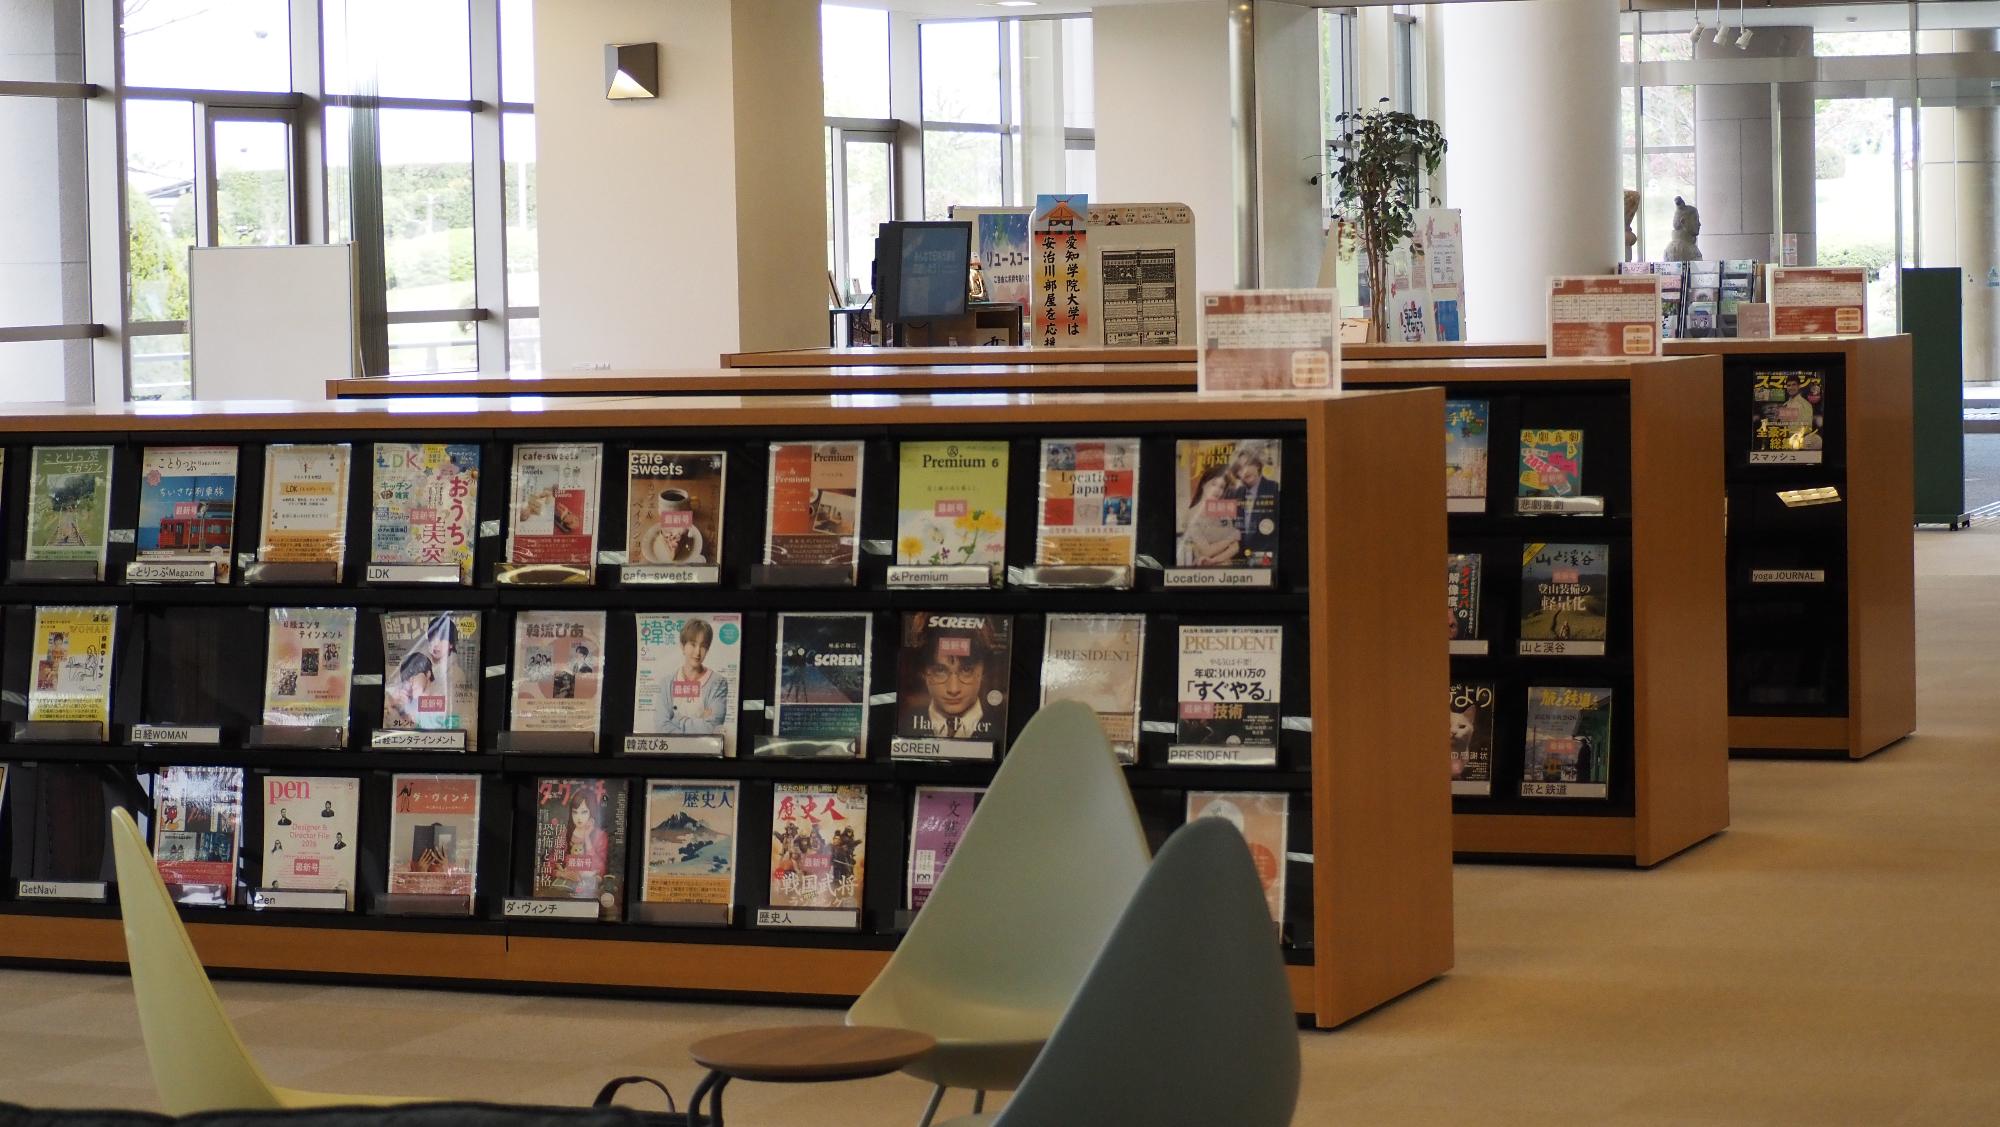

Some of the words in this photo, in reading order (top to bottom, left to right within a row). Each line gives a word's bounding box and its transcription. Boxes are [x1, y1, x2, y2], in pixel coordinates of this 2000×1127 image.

[1042, 236, 1057, 346] 安治川部屋を応援
[1065, 236, 1080, 335] 愛知学院大学は
[1522, 431, 1579, 443] 悲劇喜劇
[158, 456, 198, 471] ことりっぷ
[377, 451, 422, 471] LDK
[630, 453, 663, 464] cafe
[813, 453, 855, 463] Premium
[922, 454, 986, 468] Premium
[991, 459, 999, 468] 6
[1752, 453, 1797, 462] スマッシュ
[630, 463, 684, 475] sweets
[775, 474, 810, 483] Premium
[1061, 471, 1119, 483] Location
[160, 485, 225, 498] ちいさな列車旅
[380, 481, 413, 491] キッチン
[1070, 484, 1109, 497] Japan
[447, 475, 469, 546] おうち
[1521, 500, 1564, 510] 悲劇喜劇
[128, 566, 205, 578] ことりっぷMagazine
[369, 568, 390, 579] LDK
[623, 569, 694, 581] cafe-sweets
[1753, 572, 1773, 581] yoga
[1775, 571, 1815, 580] JOURNAL
[1165, 572, 1215, 583] Location
[1218, 572, 1253, 585] Japan
[1538, 583, 1591, 595] 登山装備の
[1541, 596, 1587, 611] 軽量化
[283, 621, 320, 629] 日経エンタ
[928, 616, 985, 630] SCREEN
[299, 631, 343, 639] テインメント
[526, 622, 584, 638] 韓流ぴあ
[1183, 635, 1278, 652] PRESIDENT
[814, 653, 862, 667] SCREEN
[1054, 649, 1131, 663] PRESIDENT
[1194, 668, 1266, 679] 年収3000万の
[673, 684, 700, 696] 最新号
[1187, 681, 1272, 702] 「すぐやる」
[1540, 689, 1595, 706] 旅と鉄道
[1213, 704, 1243, 720] 技術
[134, 730, 188, 741] 日経WOMAN
[374, 735, 456, 745] 日経エンタテインメント
[626, 739, 669, 751] 韓流ぴあ
[892, 742, 940, 754] SCREEN
[1170, 750, 1240, 761] PRESIDENT
[268, 780, 310, 805] pen
[1522, 783, 1567, 795] 旅と鉄道
[682, 791, 734, 809] 歴史人
[777, 795, 846, 824] 歴史人
[540, 823, 555, 887] 恐怖と品格
[295, 862, 320, 873] 最新号
[567, 858, 593, 869] 最新号
[20, 884, 57, 896] GetNavi
[781, 874, 858, 896] 戦国武将
[257, 895, 276, 905] Pen
[506, 902, 558, 913] ダ・ヴィンチ
[759, 912, 793, 924] 歴史人
